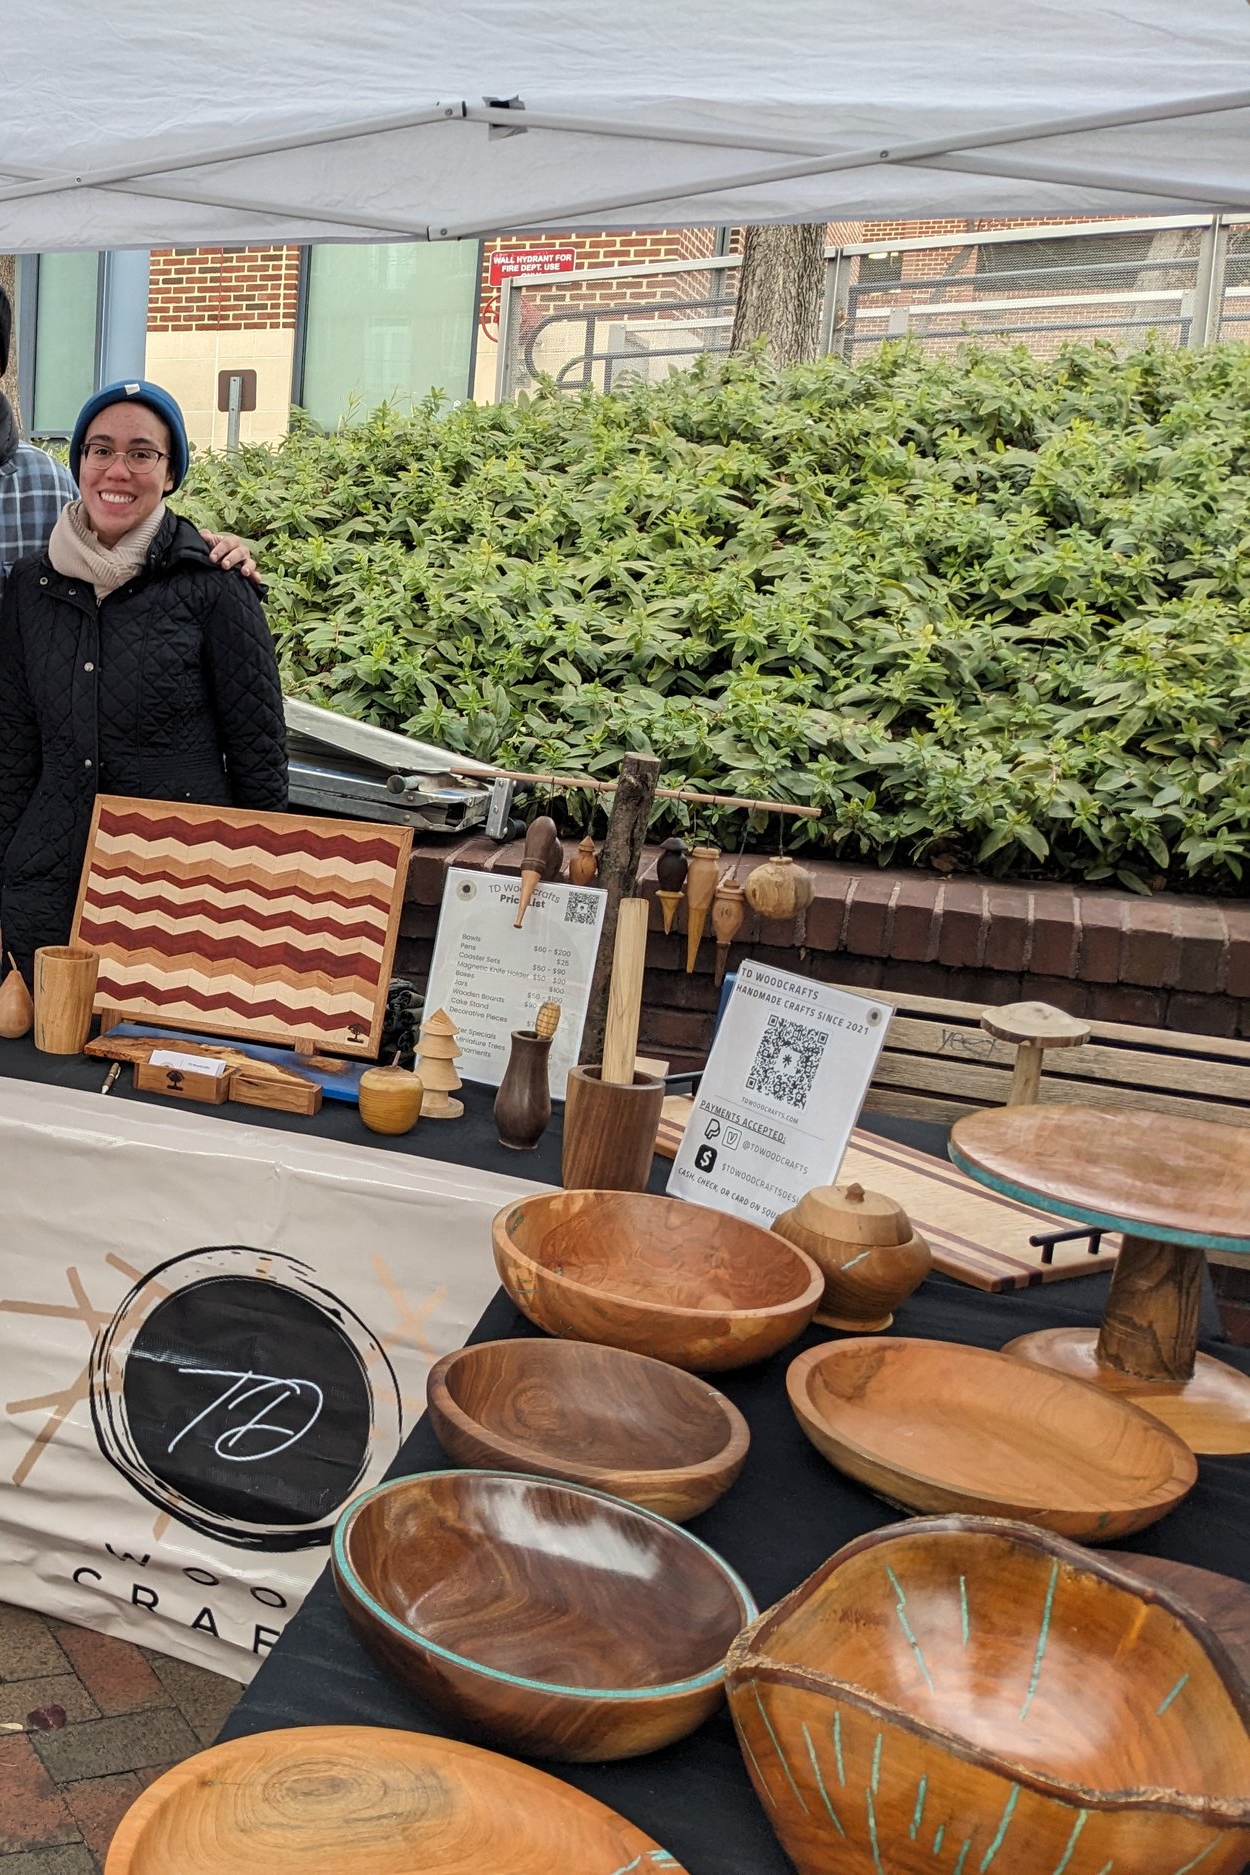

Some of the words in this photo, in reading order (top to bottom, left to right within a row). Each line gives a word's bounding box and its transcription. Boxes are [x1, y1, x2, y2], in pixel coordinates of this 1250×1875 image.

[493, 256, 515, 264] WALL
[516, 254, 554, 263] HYDRANT
[555, 253, 572, 262] FOR
[501, 264, 520, 272] FIRE
[521, 263, 542, 272] DEPT.
[488, 884, 501, 893] TD
[503, 884, 561, 903] Wocrafts
[499, 893, 520, 904] Pric
[460, 942, 476, 950] Pens
[461, 933, 481, 942] Bowls
[554, 948, 571, 957] $200
[458, 951, 485, 962] Coaster
[486, 956, 501, 964] Sets
[457, 961, 488, 972] Magnetic
[490, 964, 506, 974] Knife
[507, 968, 530, 979] Holder
[454, 979, 468, 987] Jars
[547, 995, 562, 1004] $100
[455, 970, 475, 979] Boxes
[549, 986, 565, 995] $100
[741, 967, 753, 979] TD
[755, 972, 819, 1000] WOODCRAFTS
[450, 997, 468, 1006] Cake
[469, 1000, 489, 1010] Stand
[452, 988, 480, 999] Wooden
[481, 993, 505, 1004] Boards
[449, 1006, 485, 1018] Decorative
[486, 1013, 508, 1023] Pieces
[736, 984, 783, 1006] HANDMADE
[783, 1000, 815, 1017] CRAFTS
[817, 1011, 844, 1027] SINCE
[845, 1021, 870, 1035] 2021
[468, 1029, 496, 1040] Specials
[488, 1041, 506, 1051] Trees
[700, 1099, 741, 1124] PAYMENTS
[742, 1118, 787, 1144] ACCEPTED:
[741, 1096, 799, 1124] TDWOODCRAFTS.COM
[742, 1140, 809, 1175] @TDWOODCRAFTS
[678, 1167, 695, 1182] CASH,
[697, 1176, 719, 1193] CHECK,
[720, 1187, 731, 1197] OR
[731, 1192, 749, 1206] CARD
[750, 1201, 761, 1211] ON
[721, 1162, 800, 1203] $TDWOODCRAFTSDESI
[166, 1367, 324, 1462] TD
[105, 1542, 288, 1609] WOO
[72, 1566, 281, 1654] CRAF
